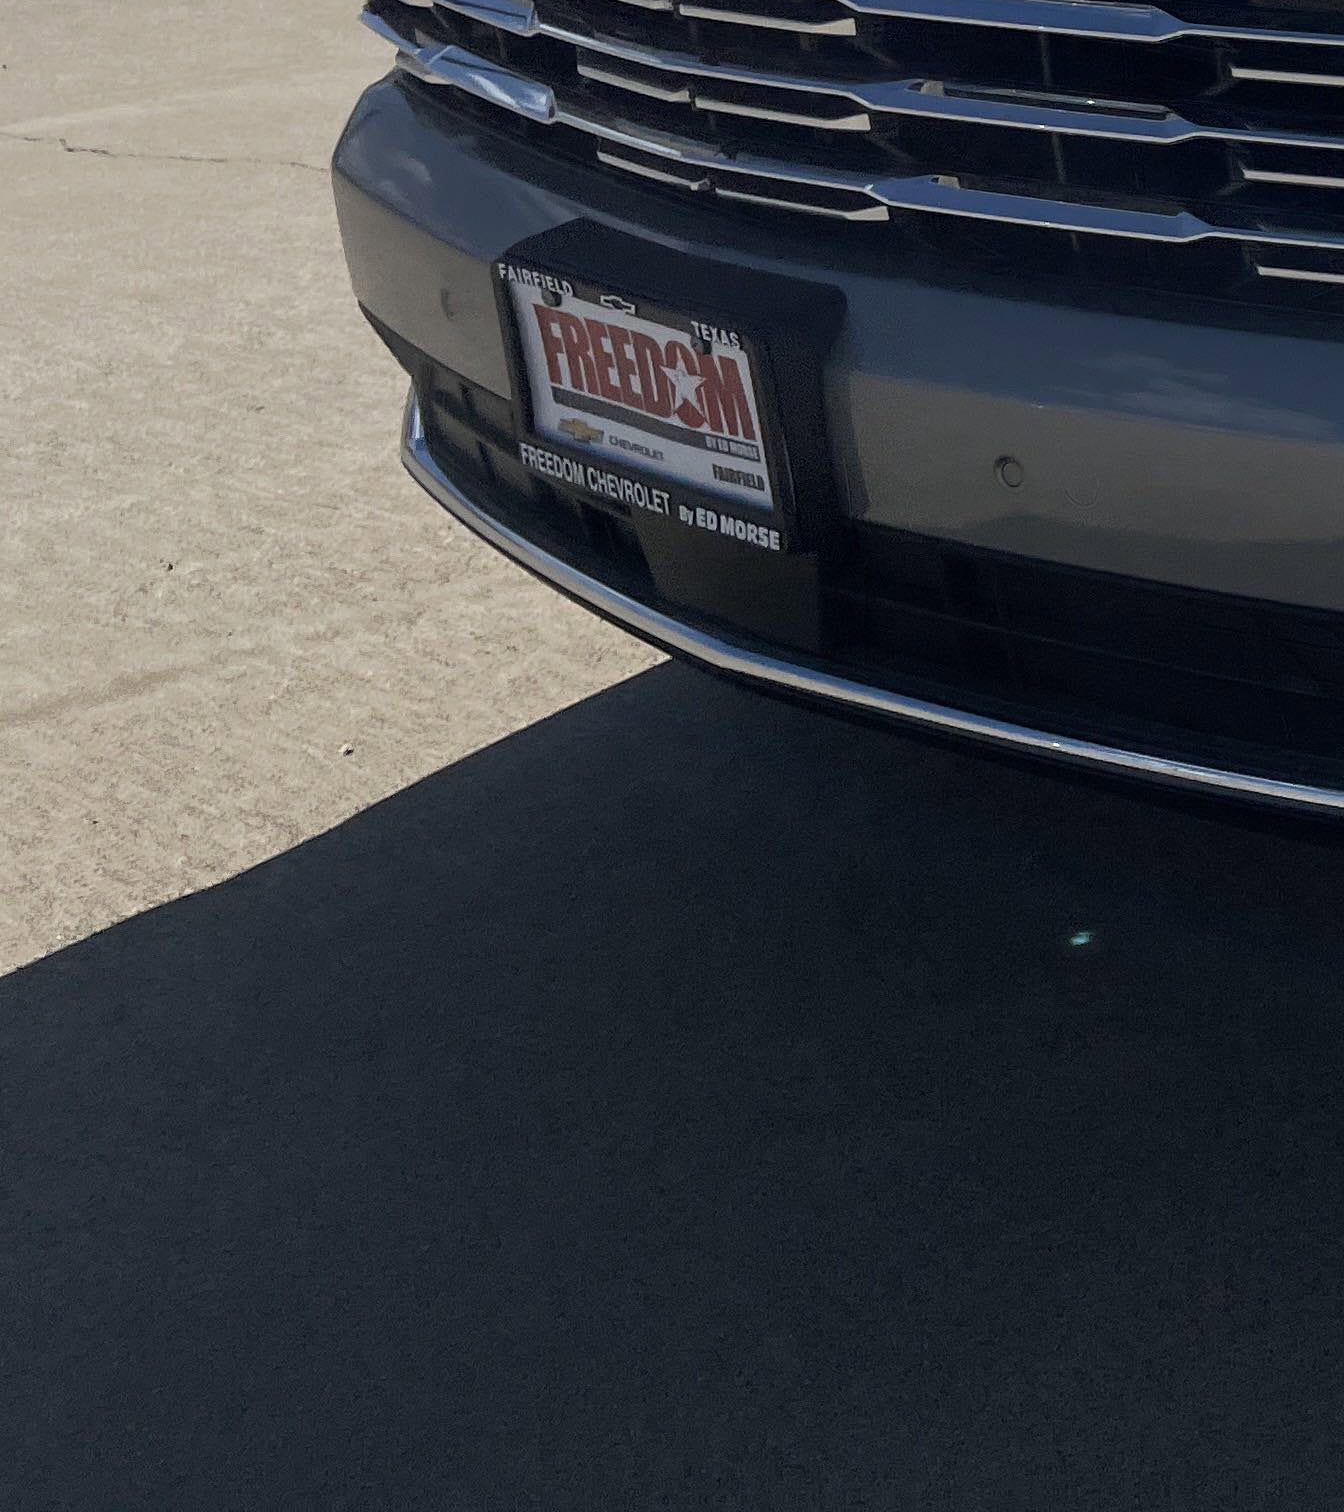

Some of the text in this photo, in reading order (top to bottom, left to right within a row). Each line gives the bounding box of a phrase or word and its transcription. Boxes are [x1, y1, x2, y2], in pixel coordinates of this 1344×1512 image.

[498, 263, 574, 297] FAIRFIELD
[691, 320, 741, 349] TEXAS
[532, 303, 757, 440] FREEDOM
[608, 435, 664, 461] CHEVROLET
[520, 443, 781, 551] FREEDOM CHEVROLET By ED MORSE
